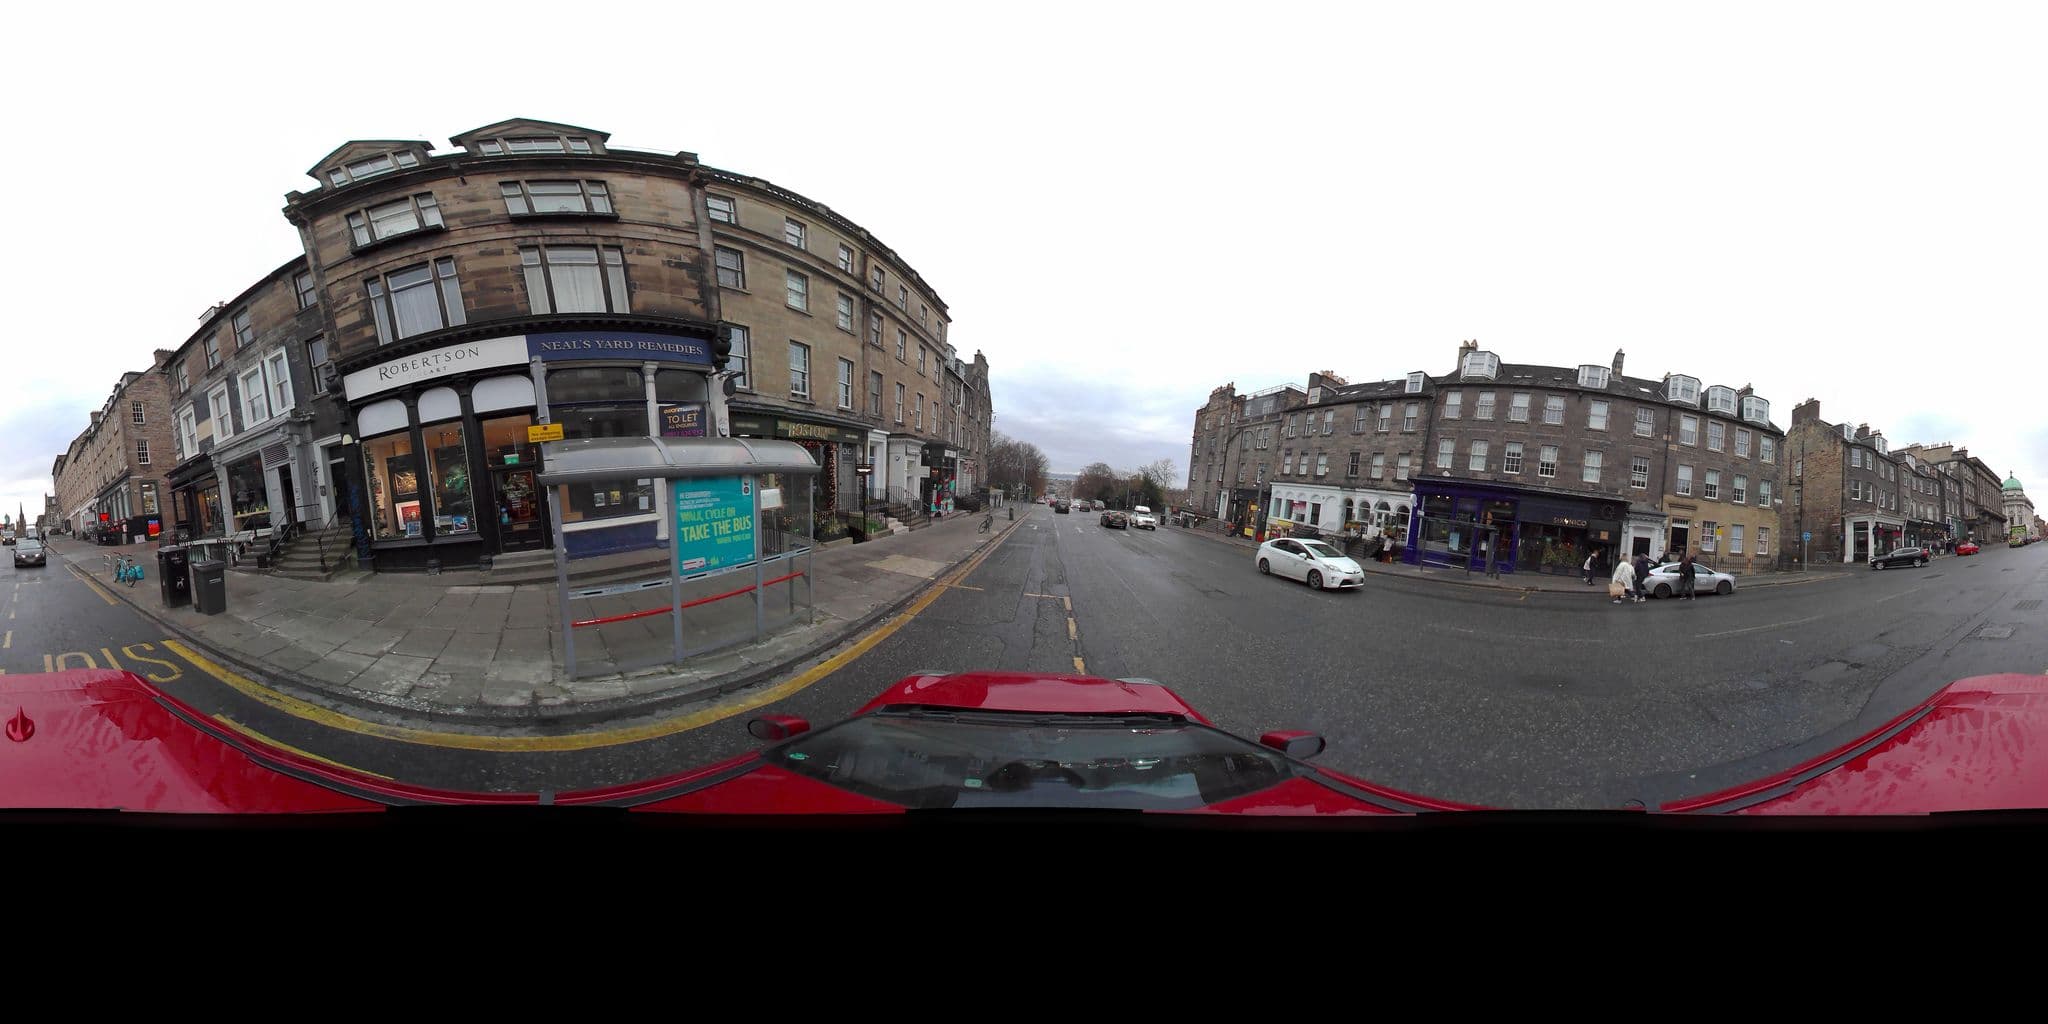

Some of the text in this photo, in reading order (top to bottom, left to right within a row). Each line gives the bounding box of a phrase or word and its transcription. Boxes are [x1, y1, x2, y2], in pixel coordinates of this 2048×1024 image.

[541, 340, 704, 356] NEAL'S YARD REMEDIES
[379, 346, 480, 381] ROBERTSON
[667, 413, 699, 425] TO LET
[681, 515, 752, 543] TAKE THE BUS
